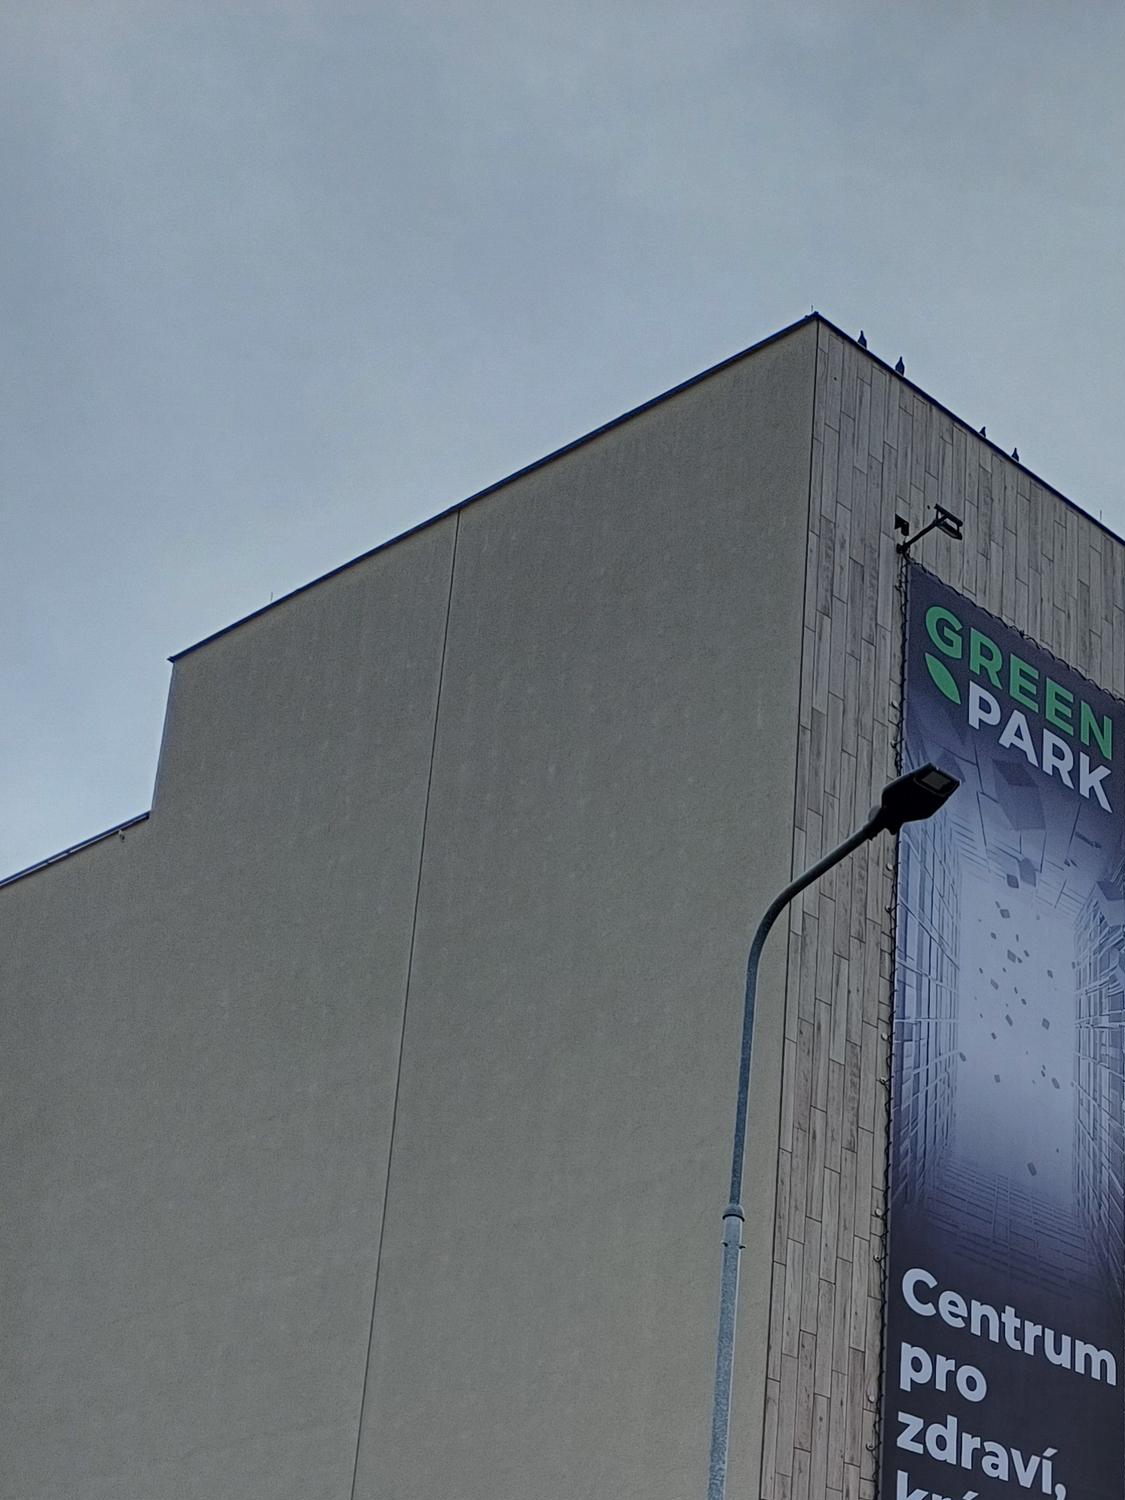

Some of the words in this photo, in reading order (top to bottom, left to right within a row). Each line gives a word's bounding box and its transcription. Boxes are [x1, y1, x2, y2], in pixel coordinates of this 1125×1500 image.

[925, 606, 1112, 760] GREEN
[968, 680, 1112, 813] PARK
[900, 1342, 988, 1402] pro
[902, 1268, 1117, 1386] Centrum
